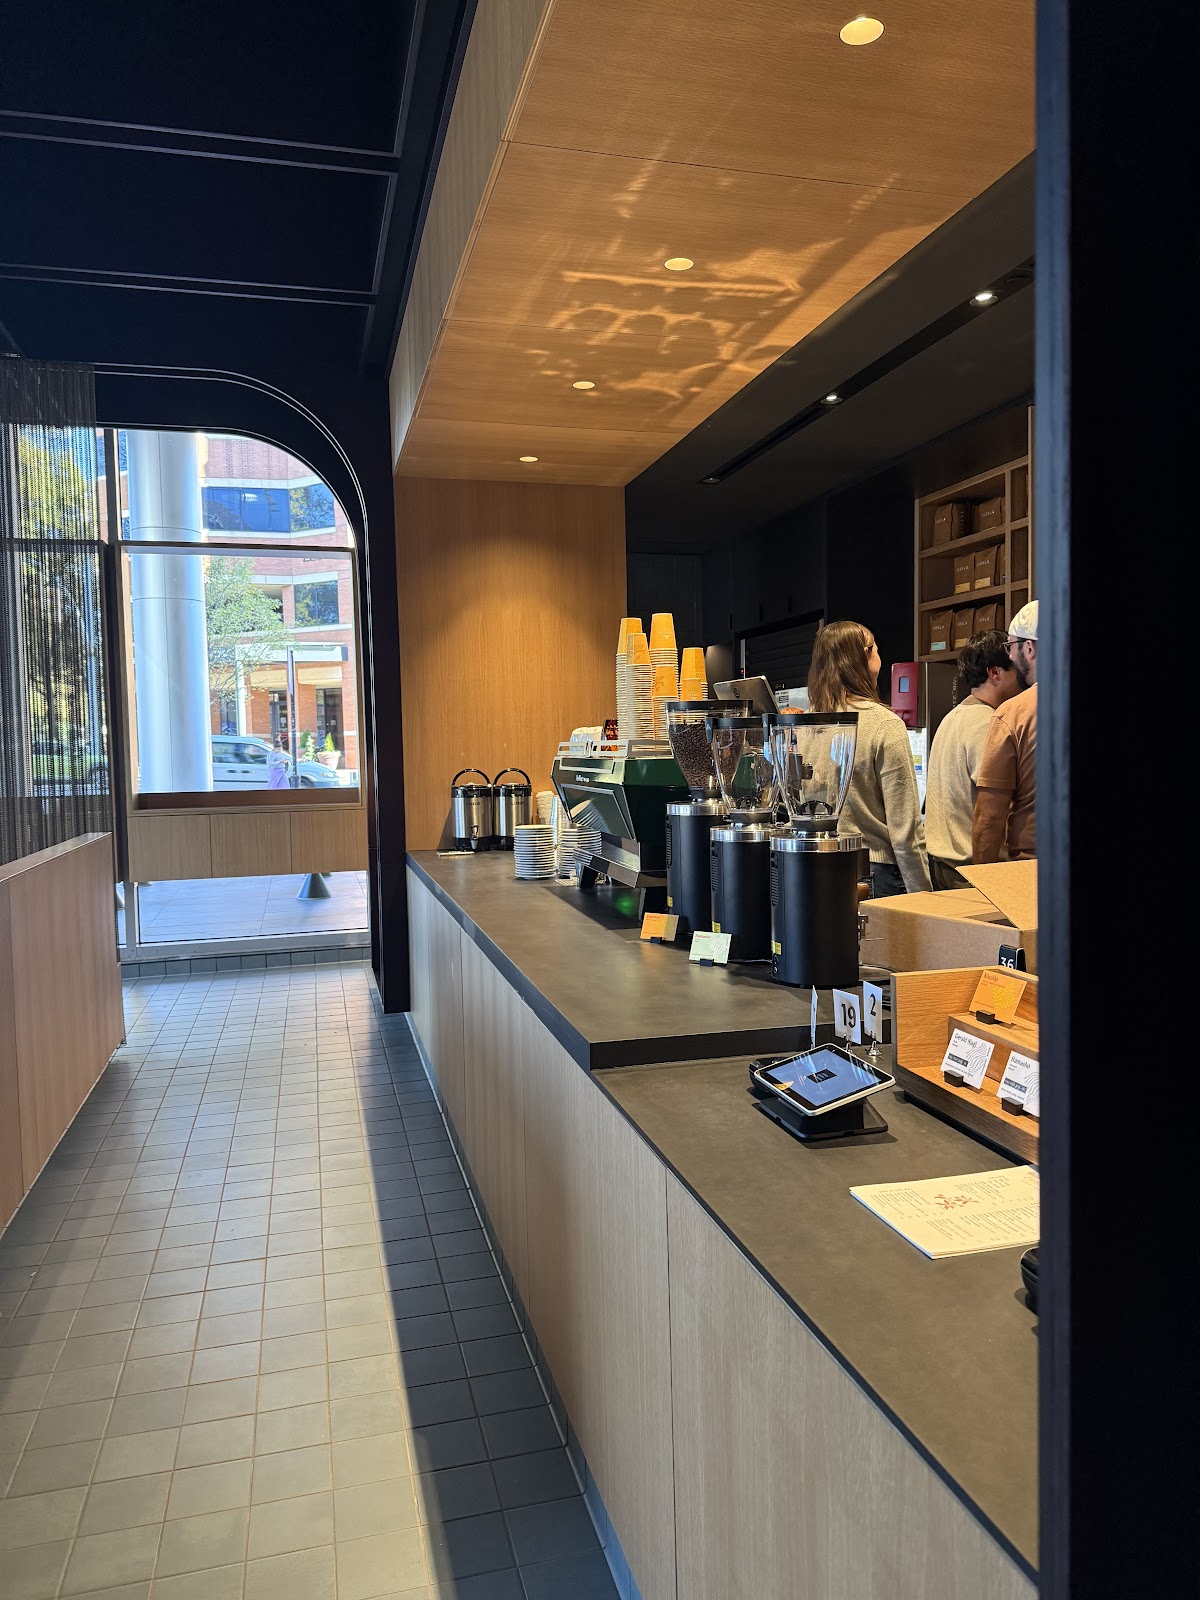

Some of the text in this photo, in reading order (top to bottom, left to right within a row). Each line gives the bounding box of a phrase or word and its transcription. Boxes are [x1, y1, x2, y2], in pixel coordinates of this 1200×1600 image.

[1000, 956, 1014, 970] 36
[841, 1003, 856, 1028] 19
[870, 993, 876, 1016] 2
